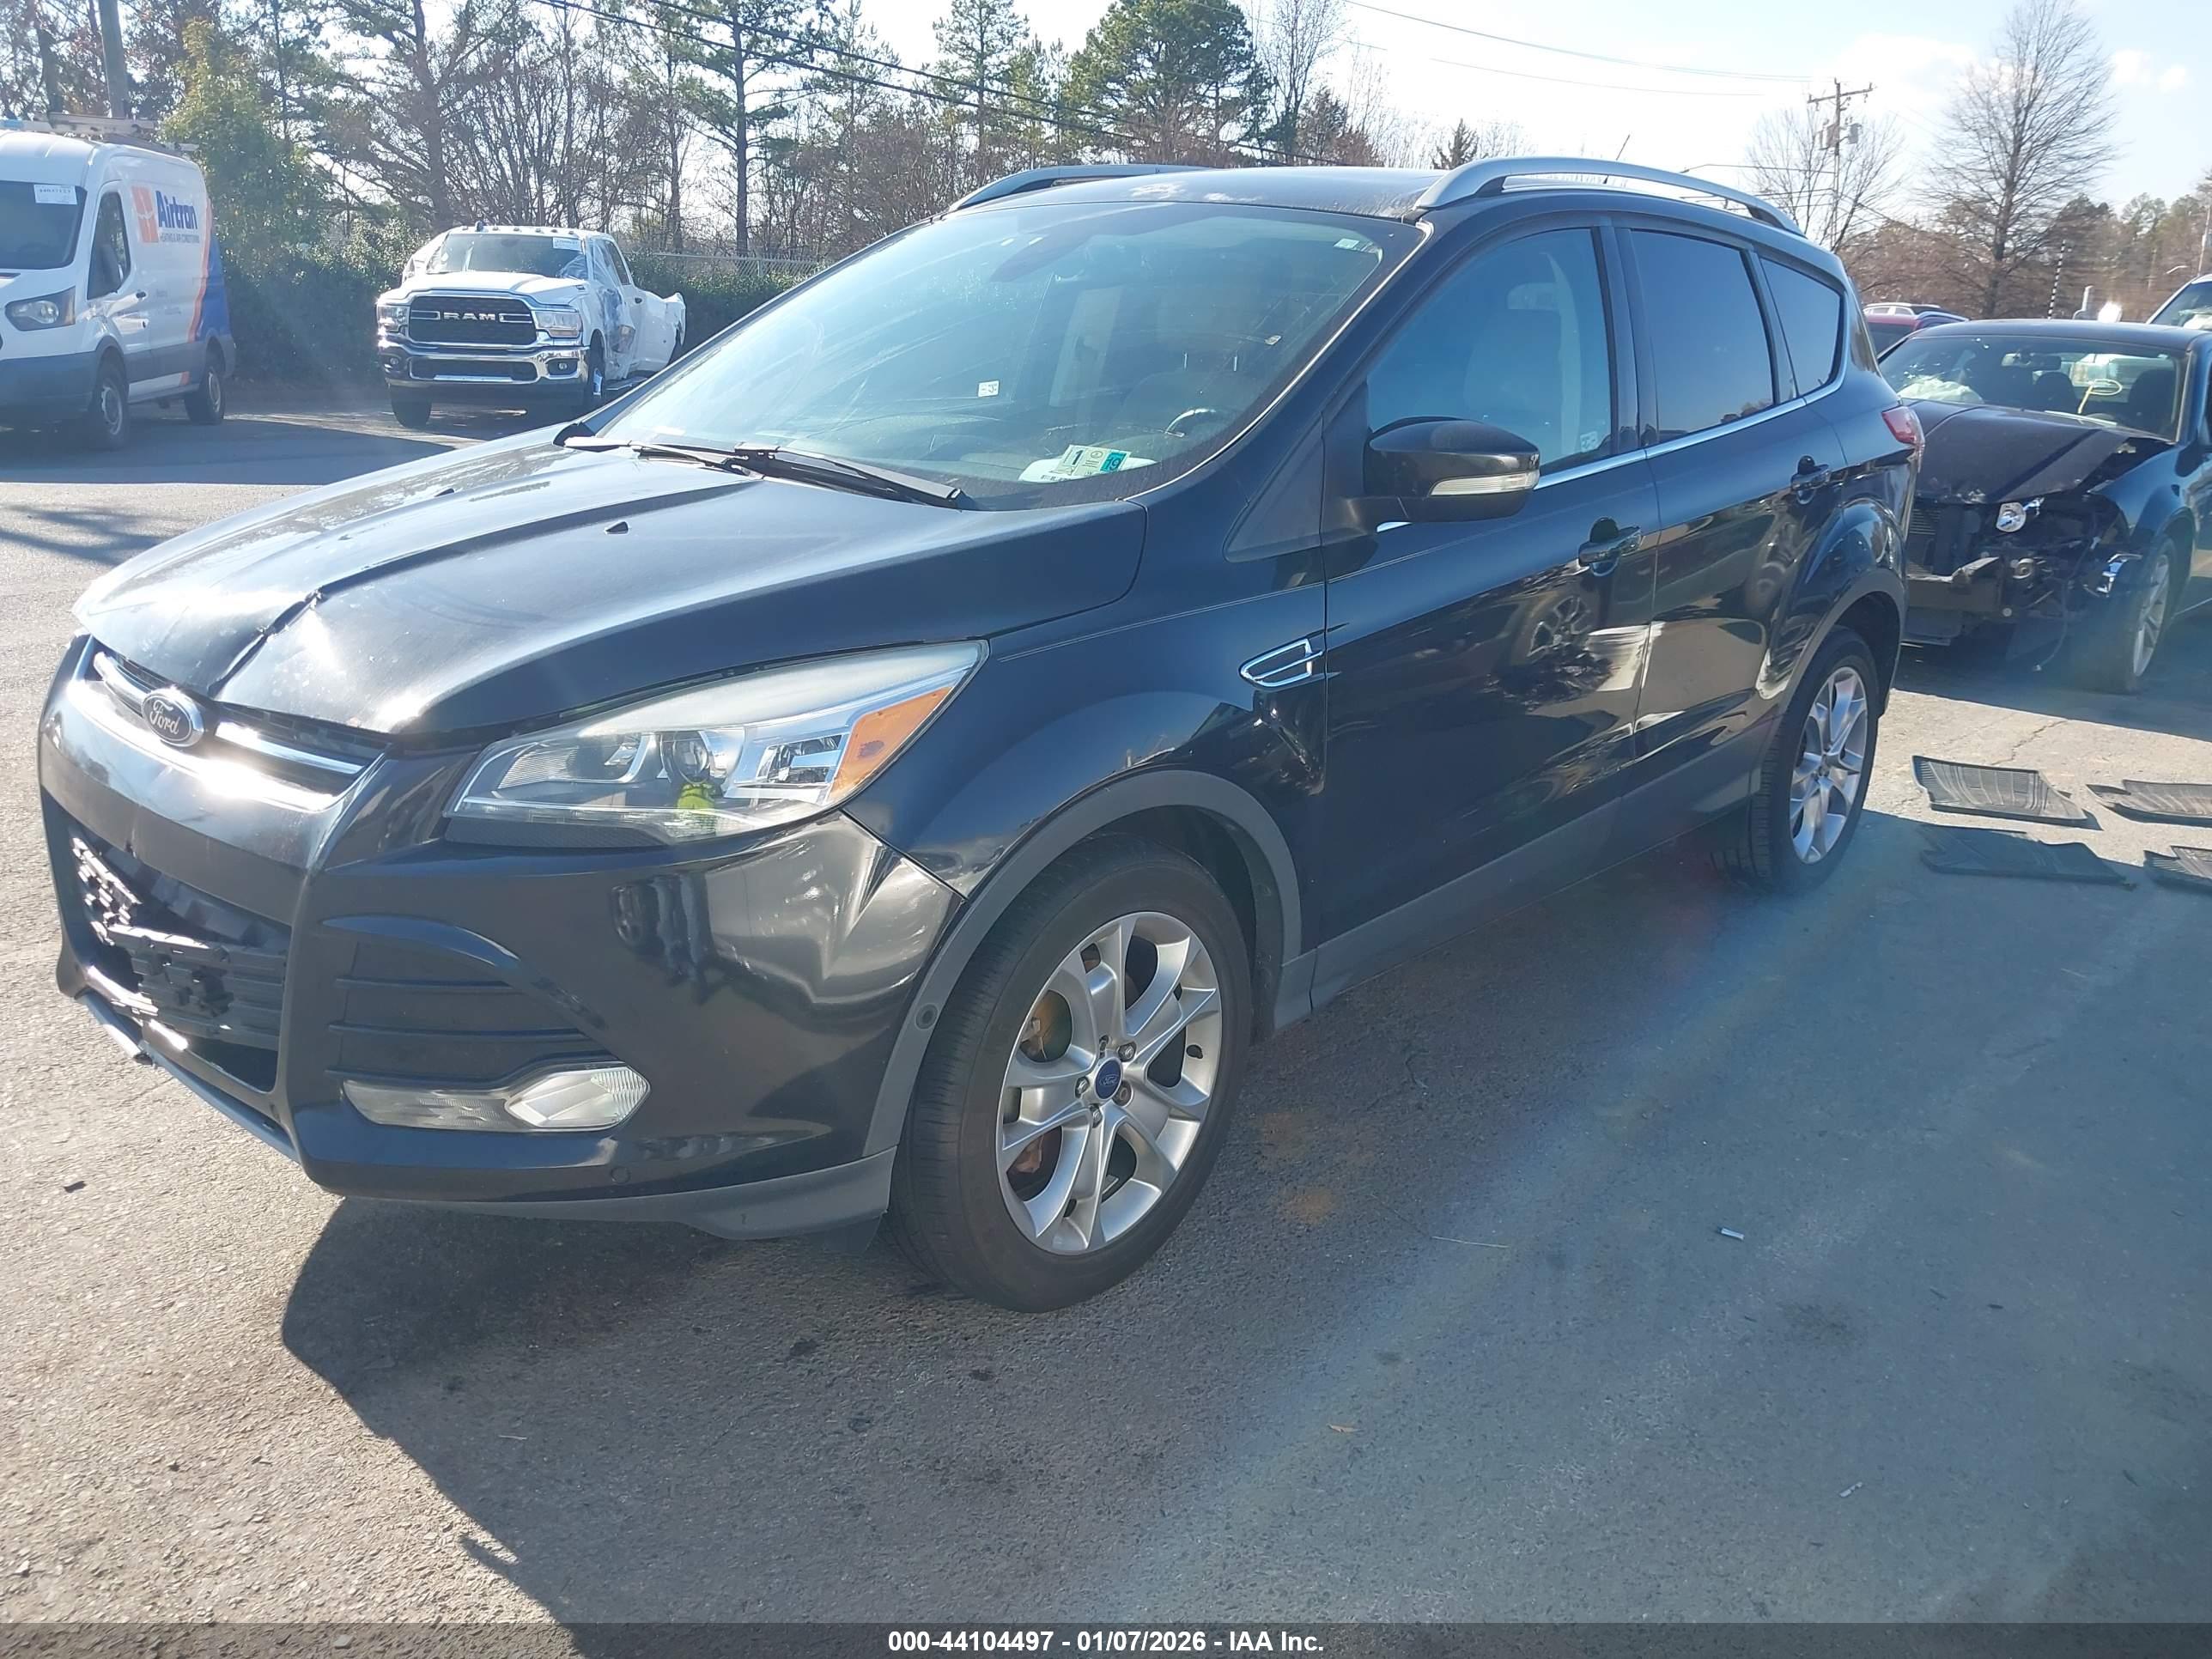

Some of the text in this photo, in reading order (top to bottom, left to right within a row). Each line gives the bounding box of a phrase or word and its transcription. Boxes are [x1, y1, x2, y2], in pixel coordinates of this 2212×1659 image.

[155, 191, 198, 229] Airtron
[443, 312, 495, 321] RAM
[1073, 450, 1083, 465] 1
[149, 700, 180, 734] Ford
